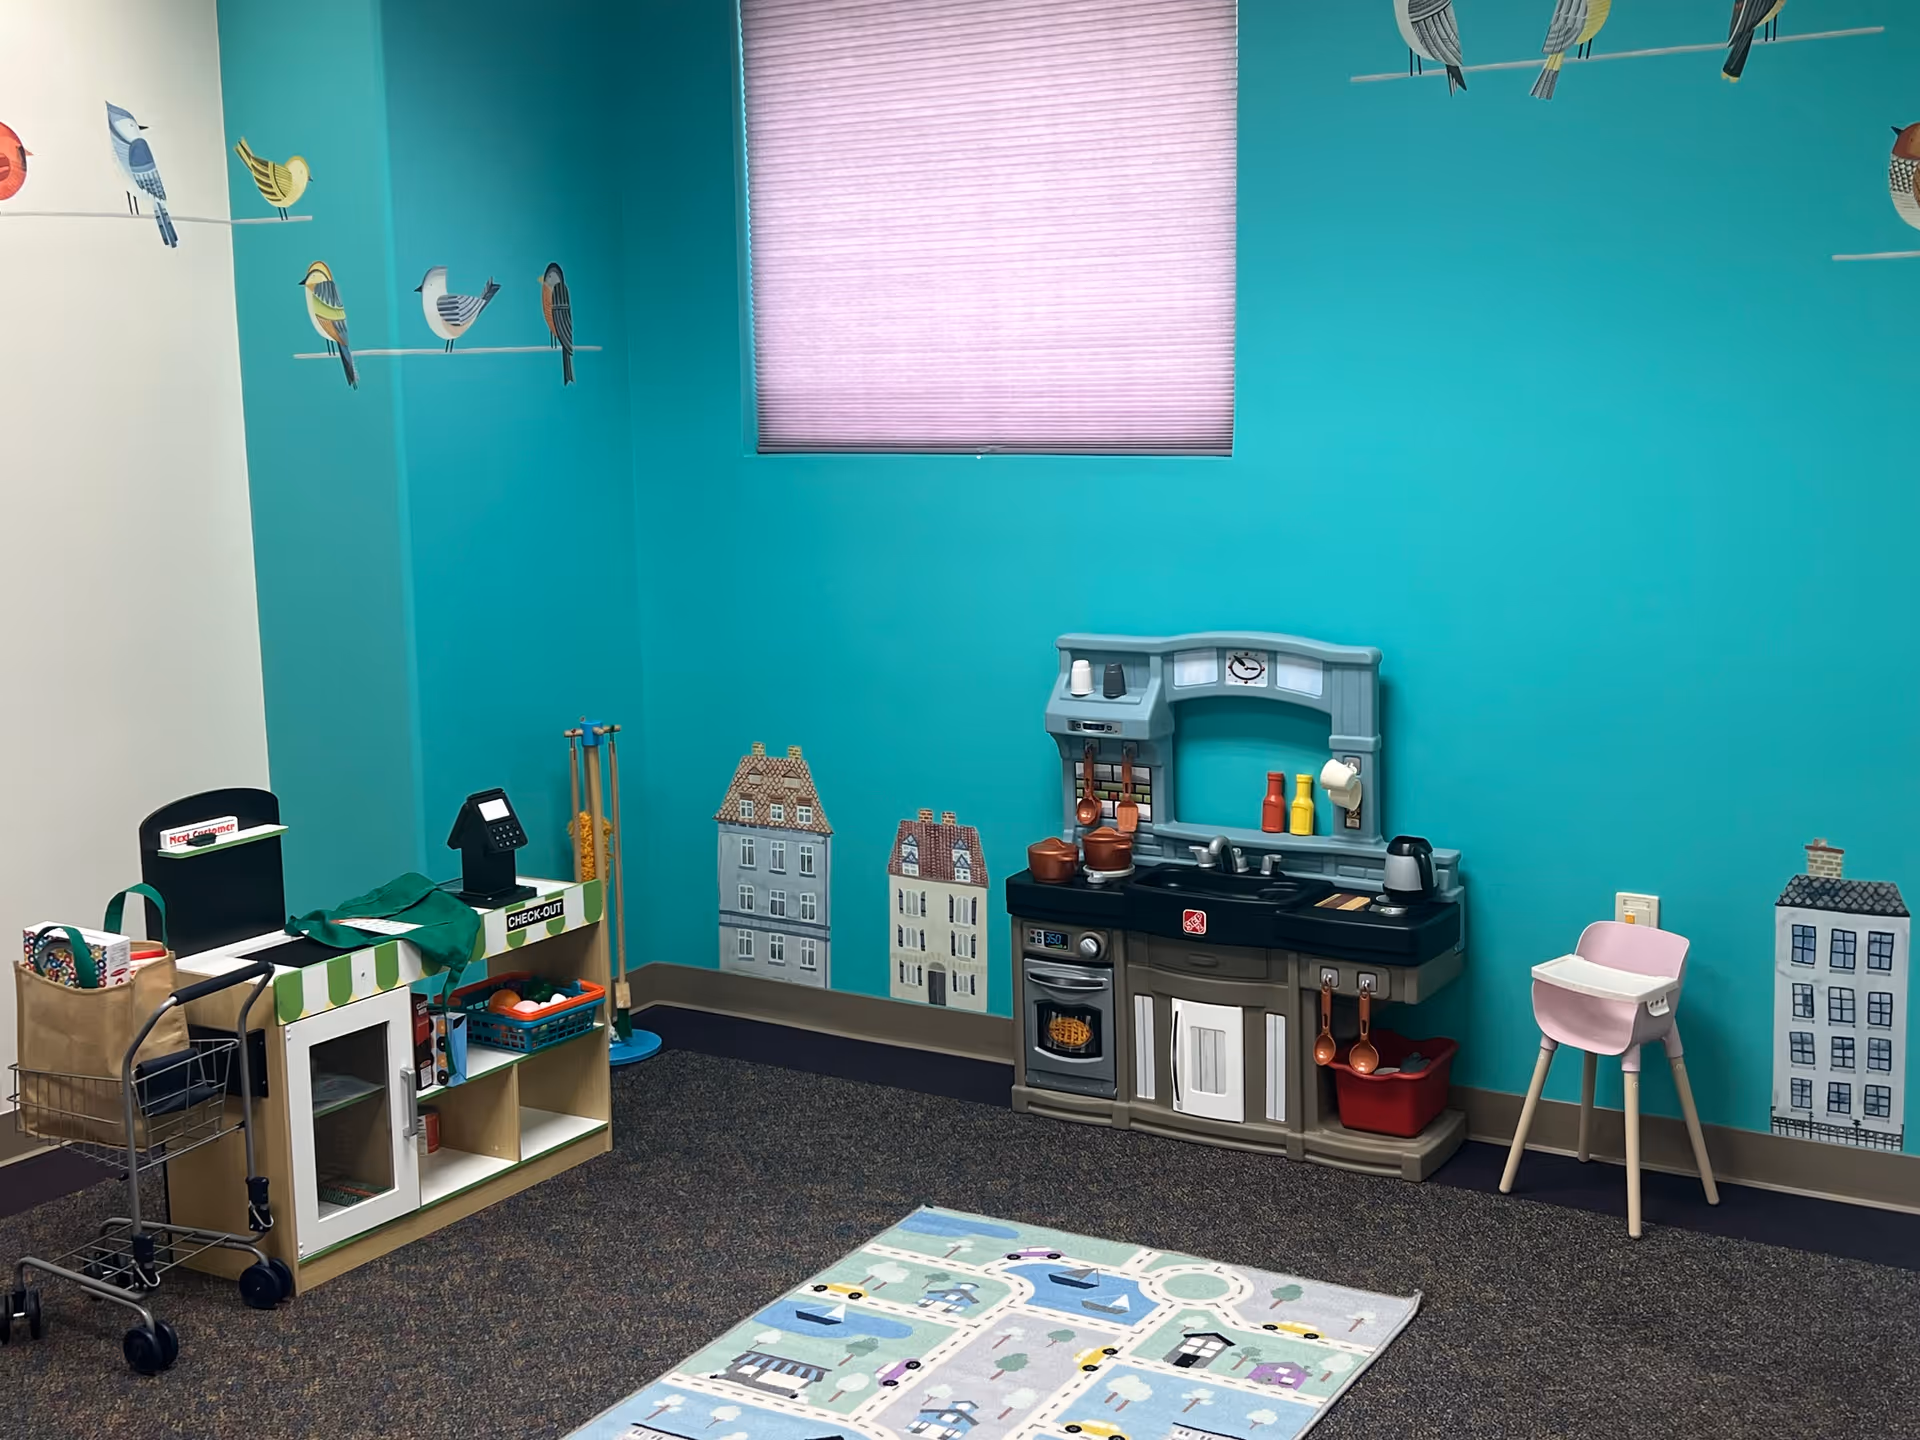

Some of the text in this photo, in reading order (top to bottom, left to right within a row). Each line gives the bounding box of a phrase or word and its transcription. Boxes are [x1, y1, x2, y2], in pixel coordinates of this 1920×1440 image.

[169, 833, 190, 844] Next
[508, 902, 562, 928] CHECK-OUT
[1045, 932, 1062, 944] 350
